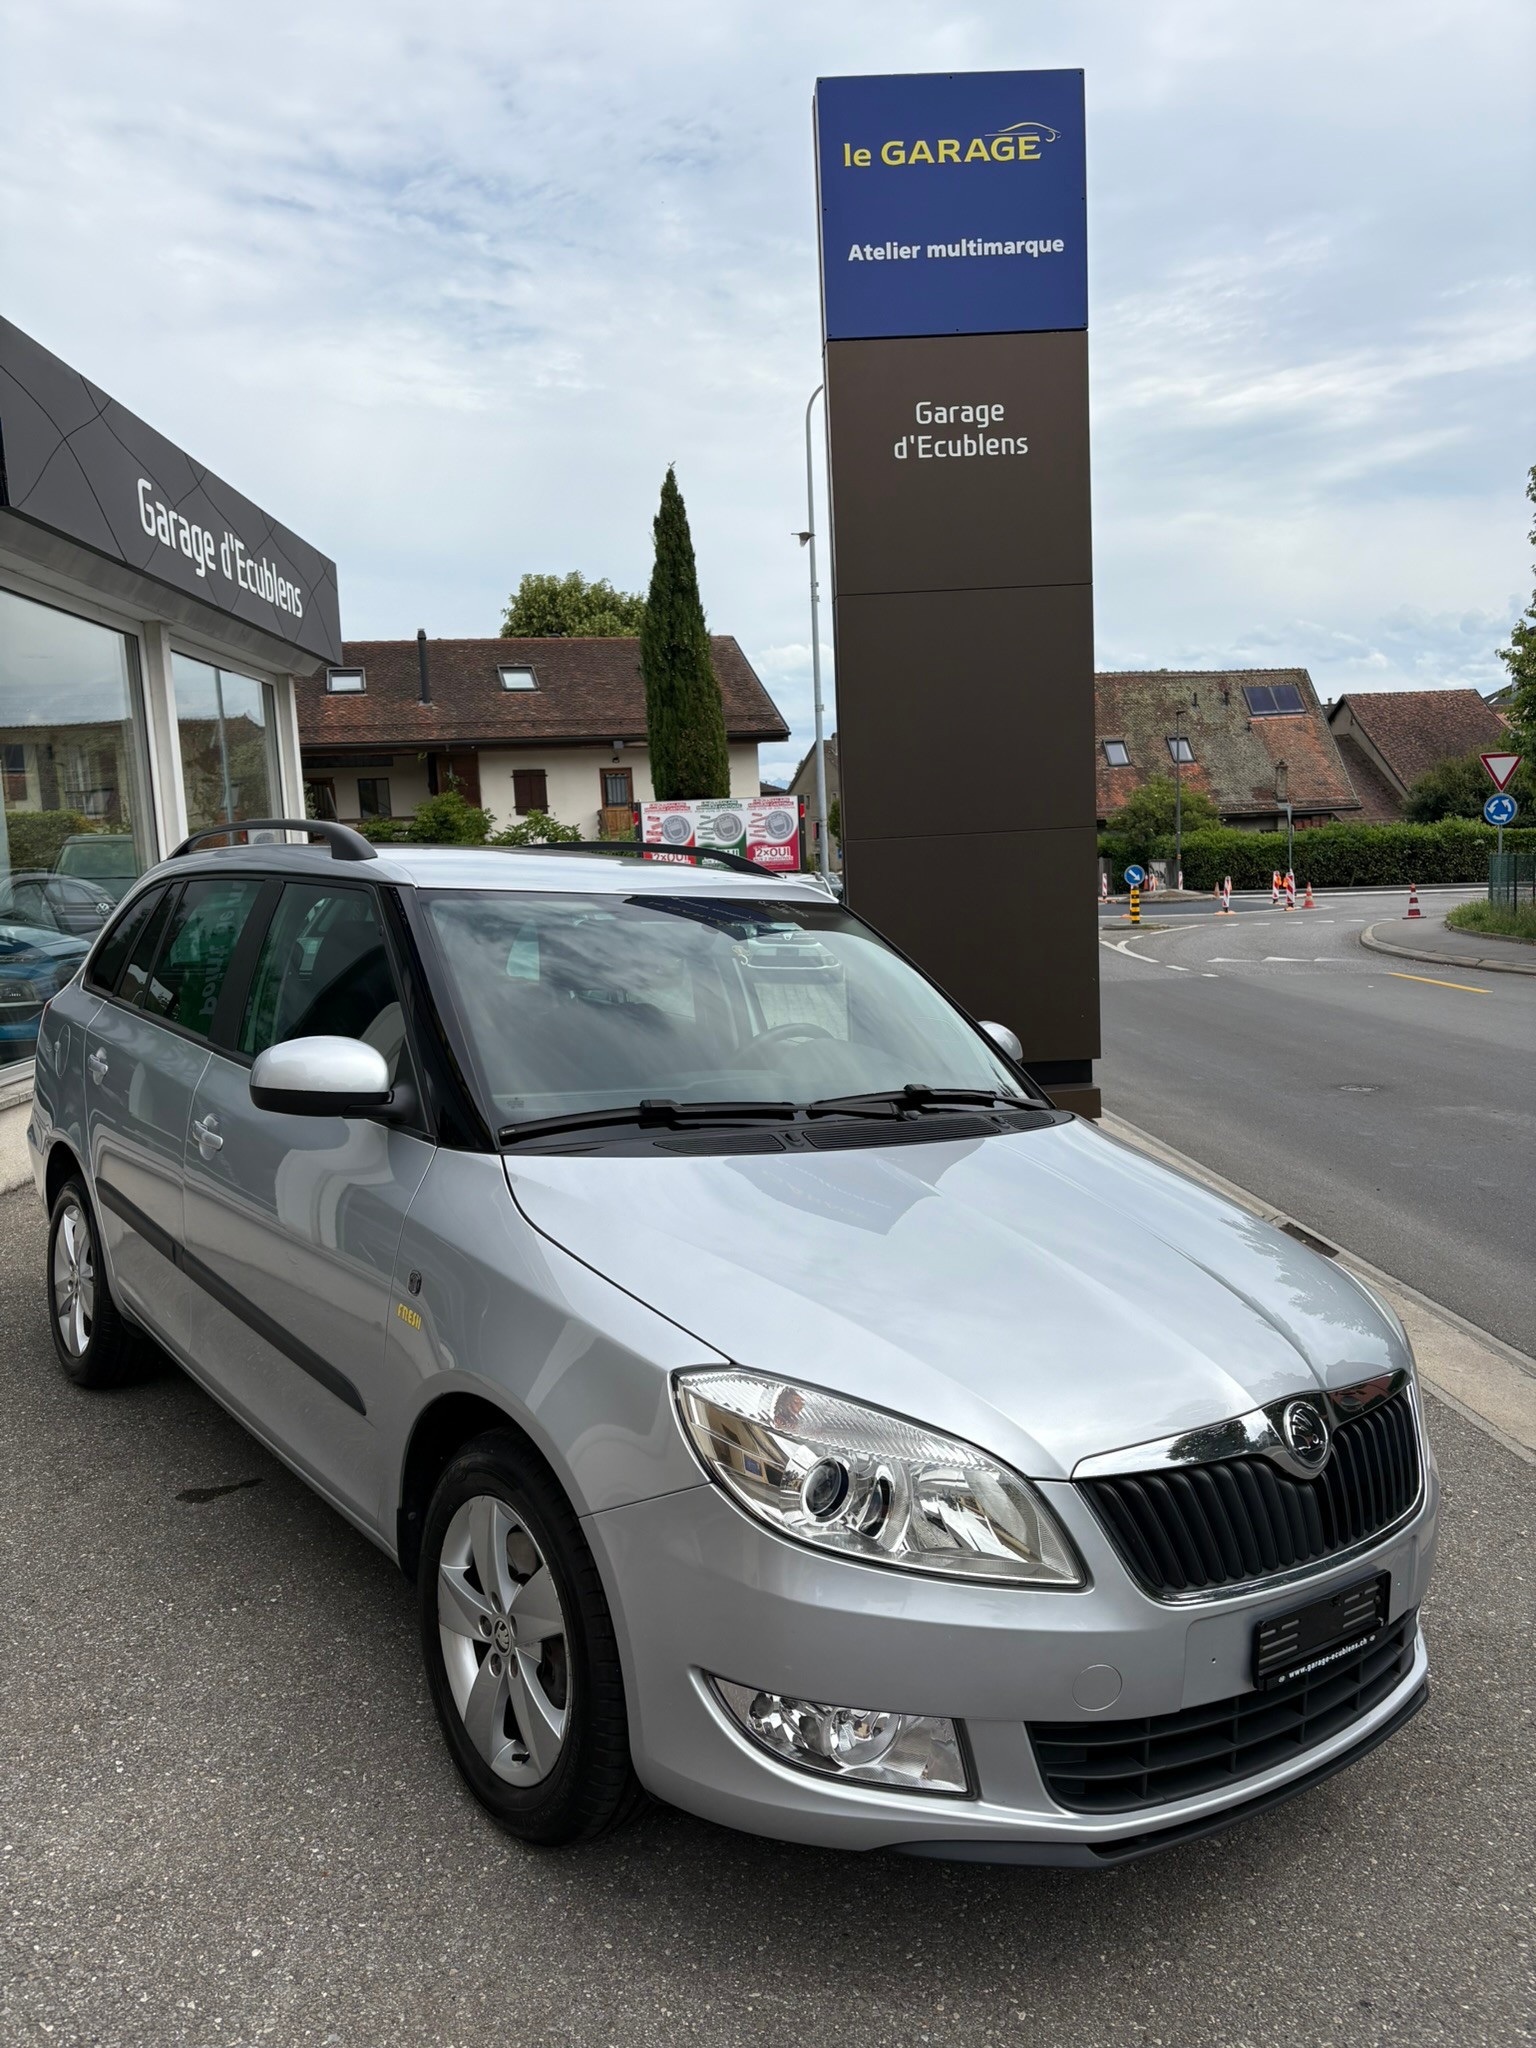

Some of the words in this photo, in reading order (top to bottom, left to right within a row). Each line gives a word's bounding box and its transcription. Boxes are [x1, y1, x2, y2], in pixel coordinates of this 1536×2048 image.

[843, 143, 871, 167] le
[881, 135, 1042, 166] GARAGE
[848, 242, 921, 261] Atelier
[926, 237, 1065, 259] multimarque
[915, 401, 1005, 428] Garage
[893, 433, 1029, 460] d'Ecublens
[137, 478, 217, 578] Garage
[220, 531, 303, 619] d'Ecublens
[1288, 1638, 1368, 1678] www.garage-ecublens.ch
